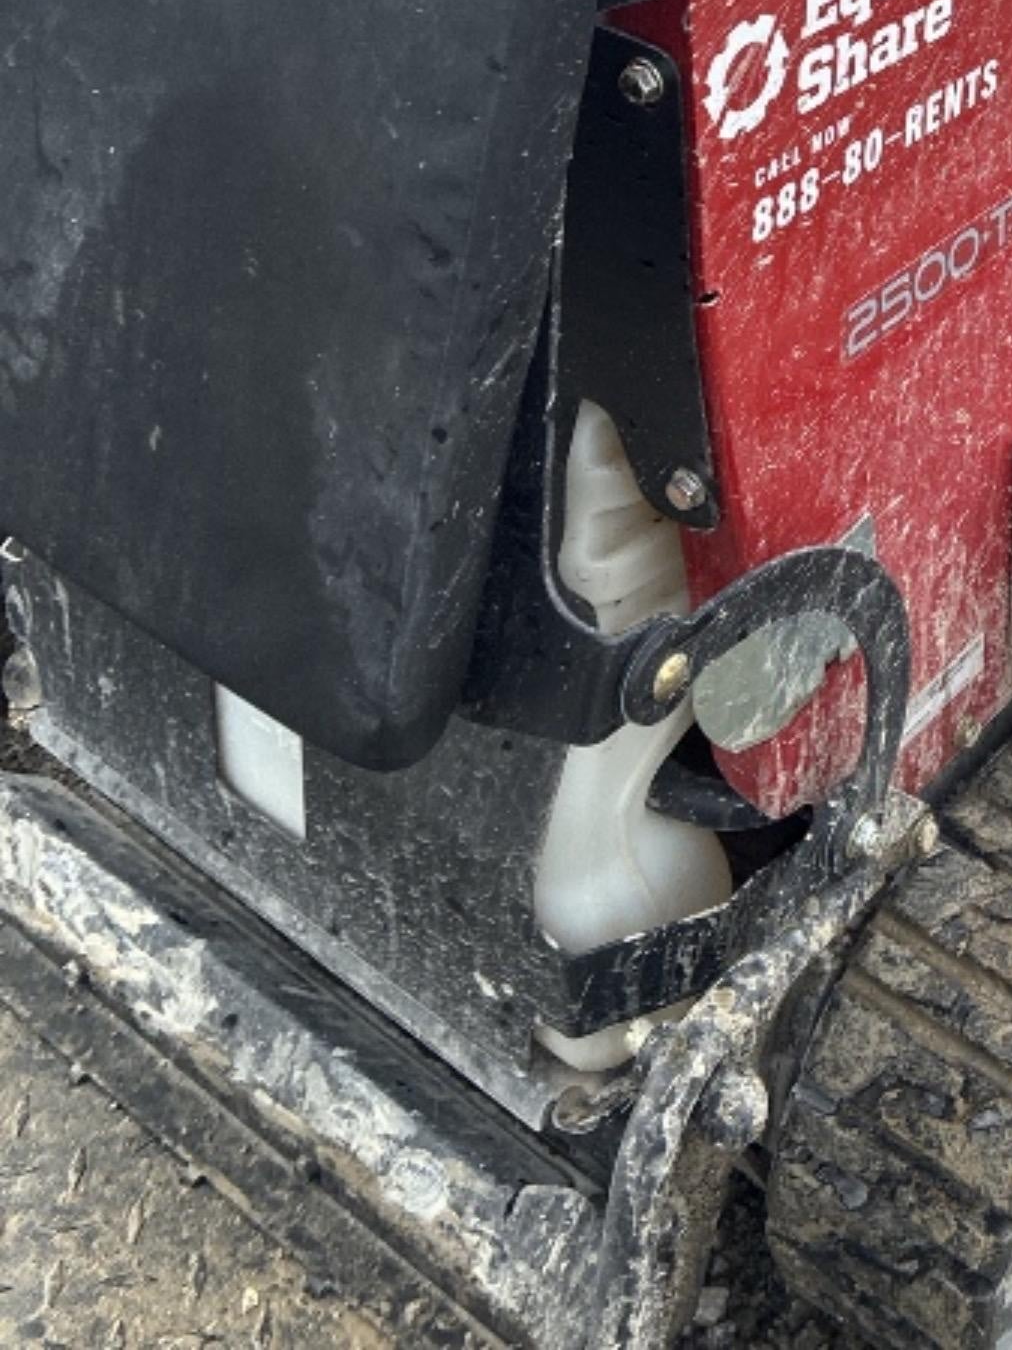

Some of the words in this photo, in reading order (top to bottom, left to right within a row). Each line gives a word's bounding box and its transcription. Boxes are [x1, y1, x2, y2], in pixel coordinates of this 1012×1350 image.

[752, 59, 999, 244] 888-80-RENTS
[754, 146, 802, 189] CALL
[810, 115, 852, 154] NOW
